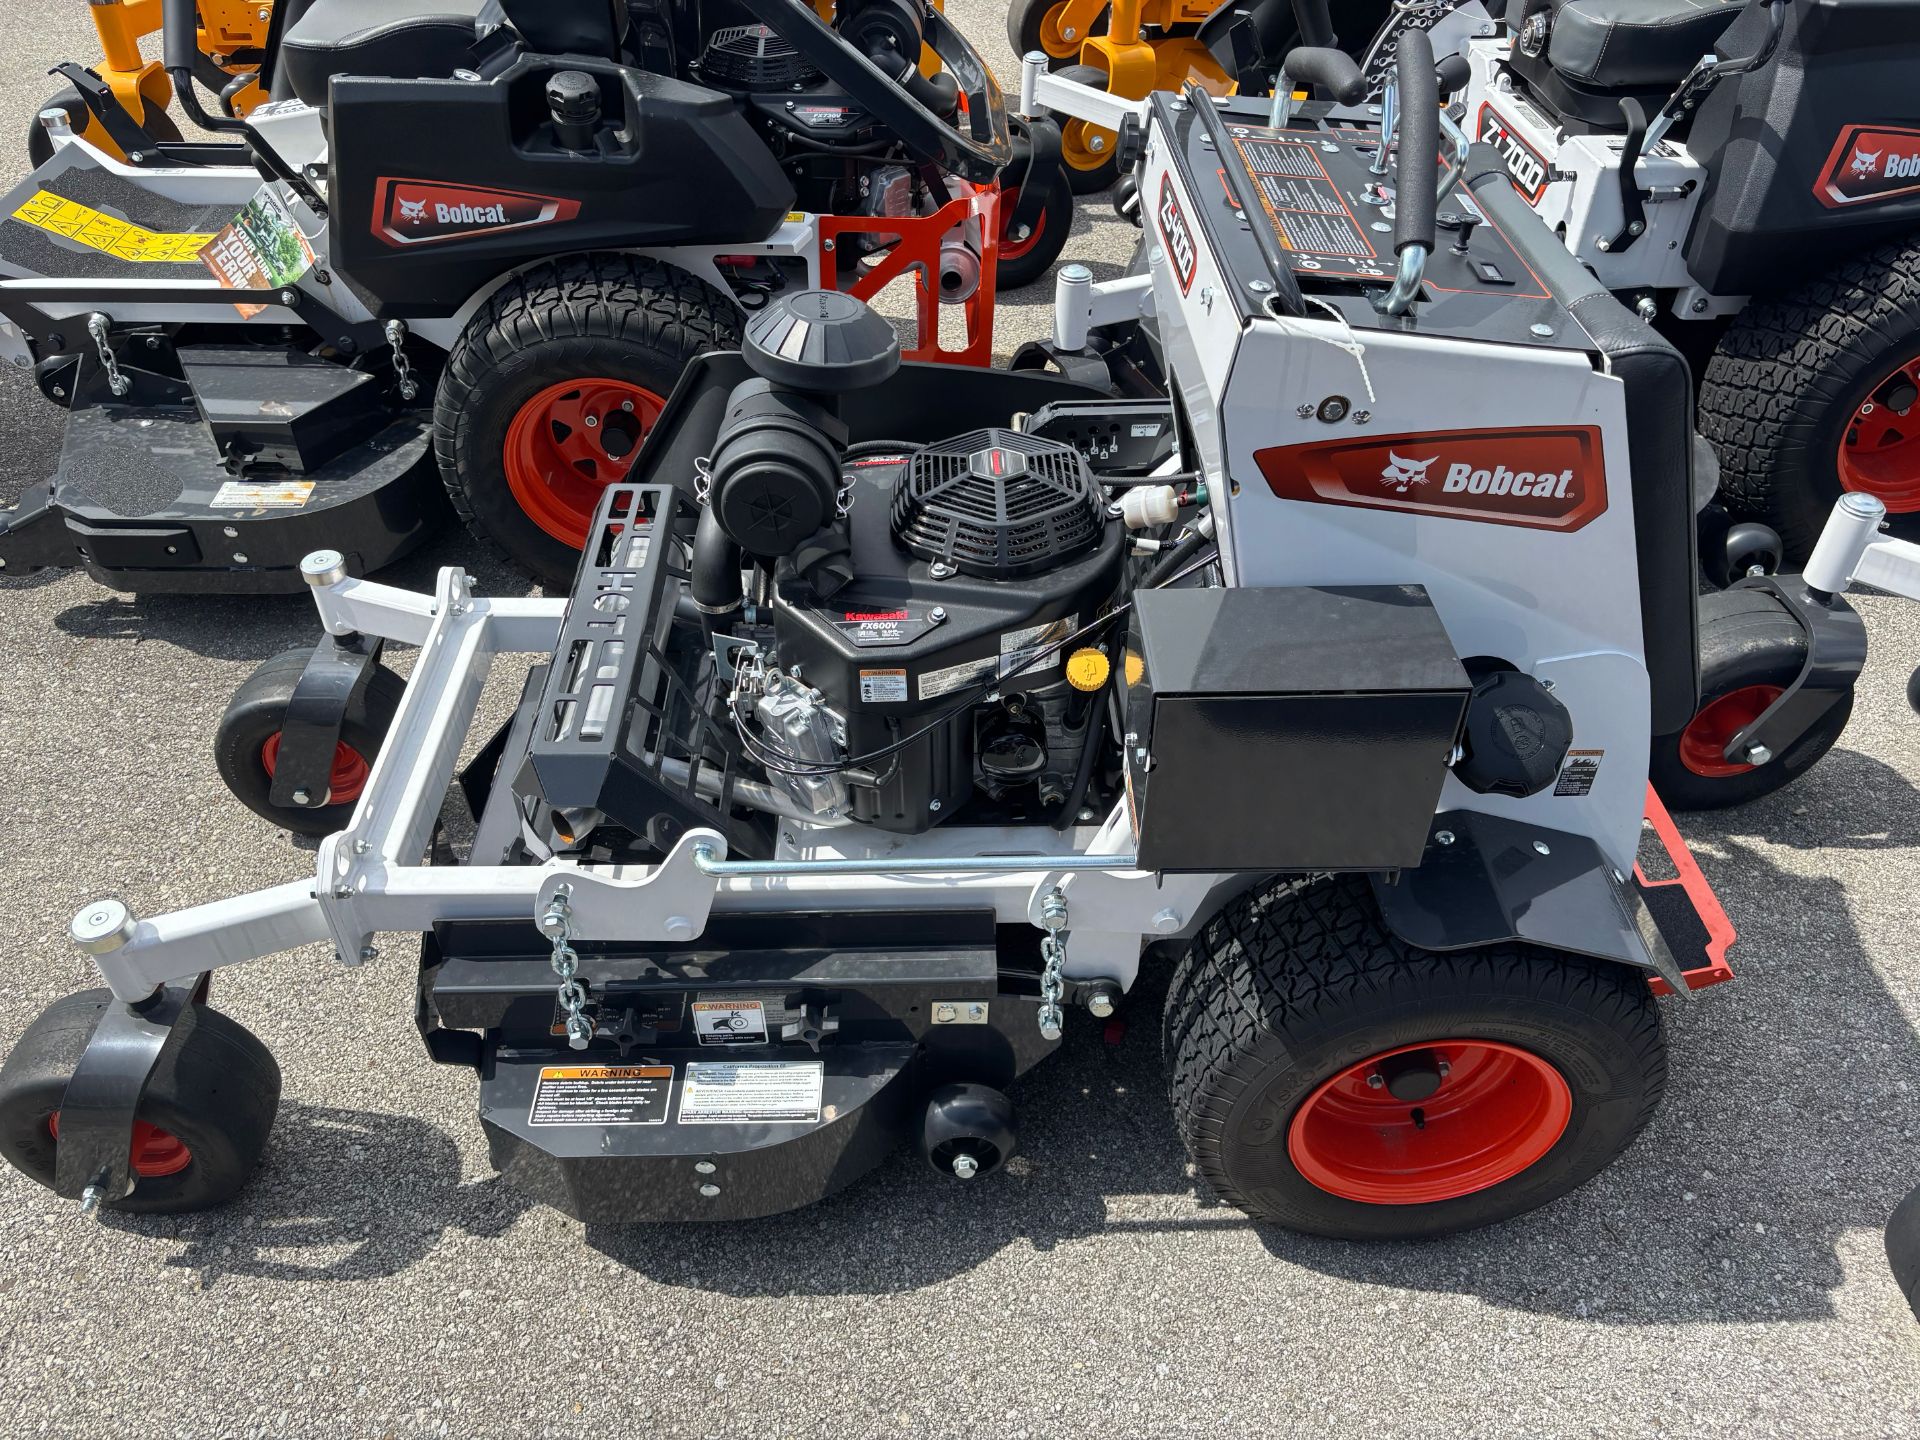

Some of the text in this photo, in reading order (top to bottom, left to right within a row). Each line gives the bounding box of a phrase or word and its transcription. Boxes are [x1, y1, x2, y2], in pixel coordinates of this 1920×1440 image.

[1481, 117, 1544, 195] ZT7000
[434, 203, 506, 224] Bobcat
[222, 229, 258, 278] YOUR
[234, 222, 274, 281] YOUR TURF
[1160, 190, 1195, 283] ZS4000
[1442, 463, 1573, 499] Bobcat
[845, 609, 909, 620] Kawasaki
[580, 1069, 642, 1077] WARNING
